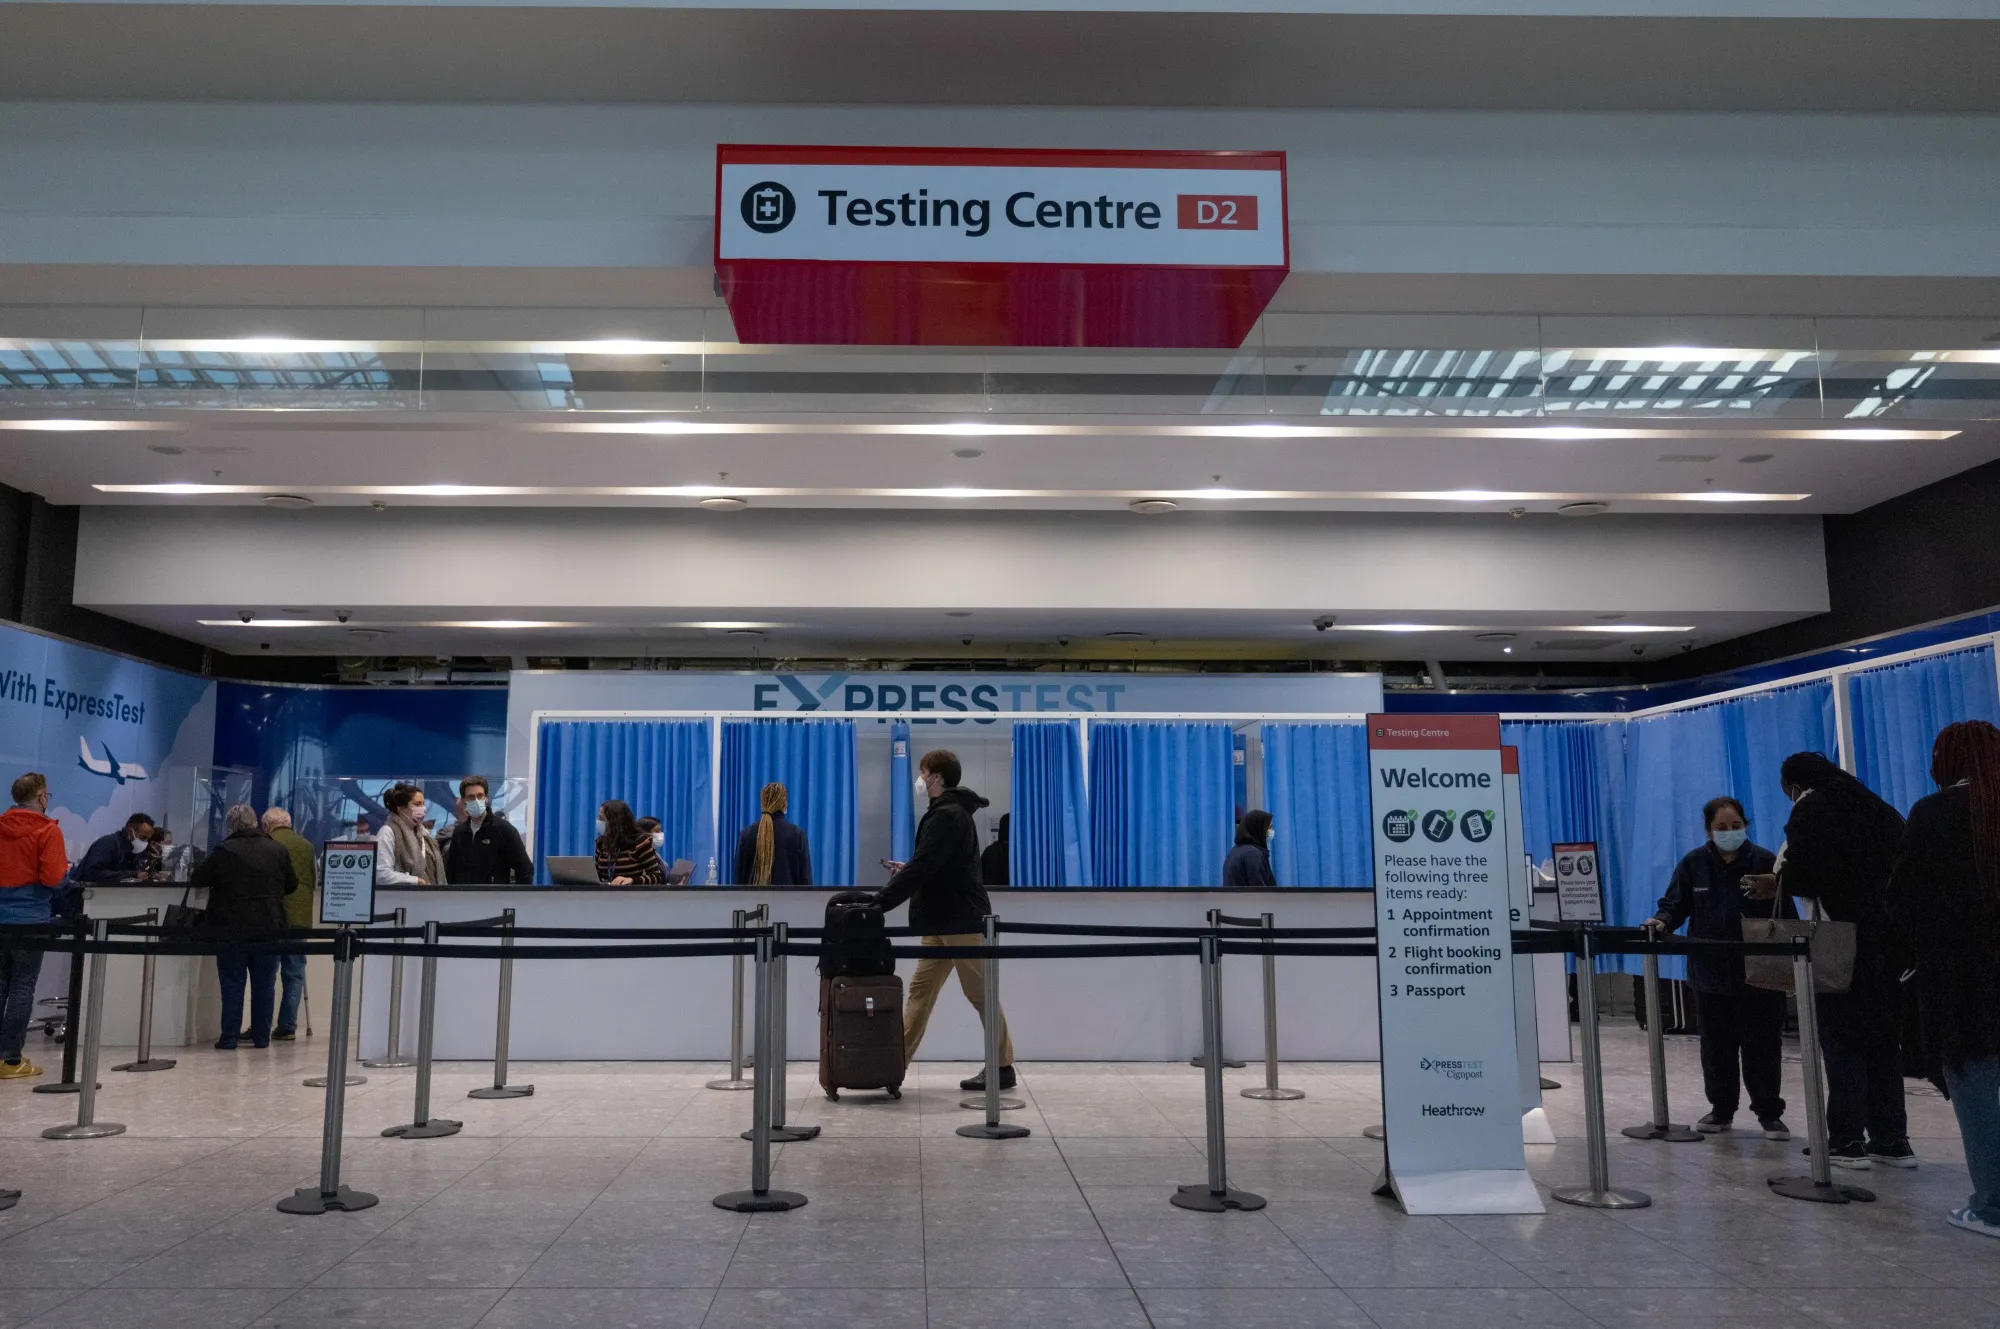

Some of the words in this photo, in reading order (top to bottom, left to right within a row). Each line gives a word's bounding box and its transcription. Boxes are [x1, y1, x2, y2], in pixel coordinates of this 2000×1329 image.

[818, 189, 990, 237] Testing
[1005, 191, 1161, 230] Centre
[1197, 201, 1238, 225] D2
[44, 678, 145, 725] ExpressTest
[1387, 728, 1419, 739] Testing
[1421, 728, 1450, 737] Centre
[1380, 767, 1491, 788] Welcome
[1384, 854, 1427, 866] Please
[1430, 855, 1462, 866] have
[1466, 855, 1488, 866] the
[1385, 870, 1450, 886] following
[1453, 871, 1488, 882] three
[1386, 887, 1423, 899] items
[1426, 887, 1468, 901] ready:
[1388, 909, 1395, 920] 1
[1403, 908, 1493, 923] Appointment
[1403, 925, 1490, 937] confirmation
[1389, 947, 1396, 958] 2
[1405, 946, 1443, 961] Flight
[1447, 946, 1501, 960] booking
[1405, 962, 1492, 975] confirmation
[1390, 985, 1398, 996] 3
[1406, 985, 1466, 999] Passport
[1420, 1057, 1483, 1073] EXPRESSTEST
[1446, 1070, 1483, 1080] Cignpost
[1422, 1104, 1485, 1116] Heathrow
